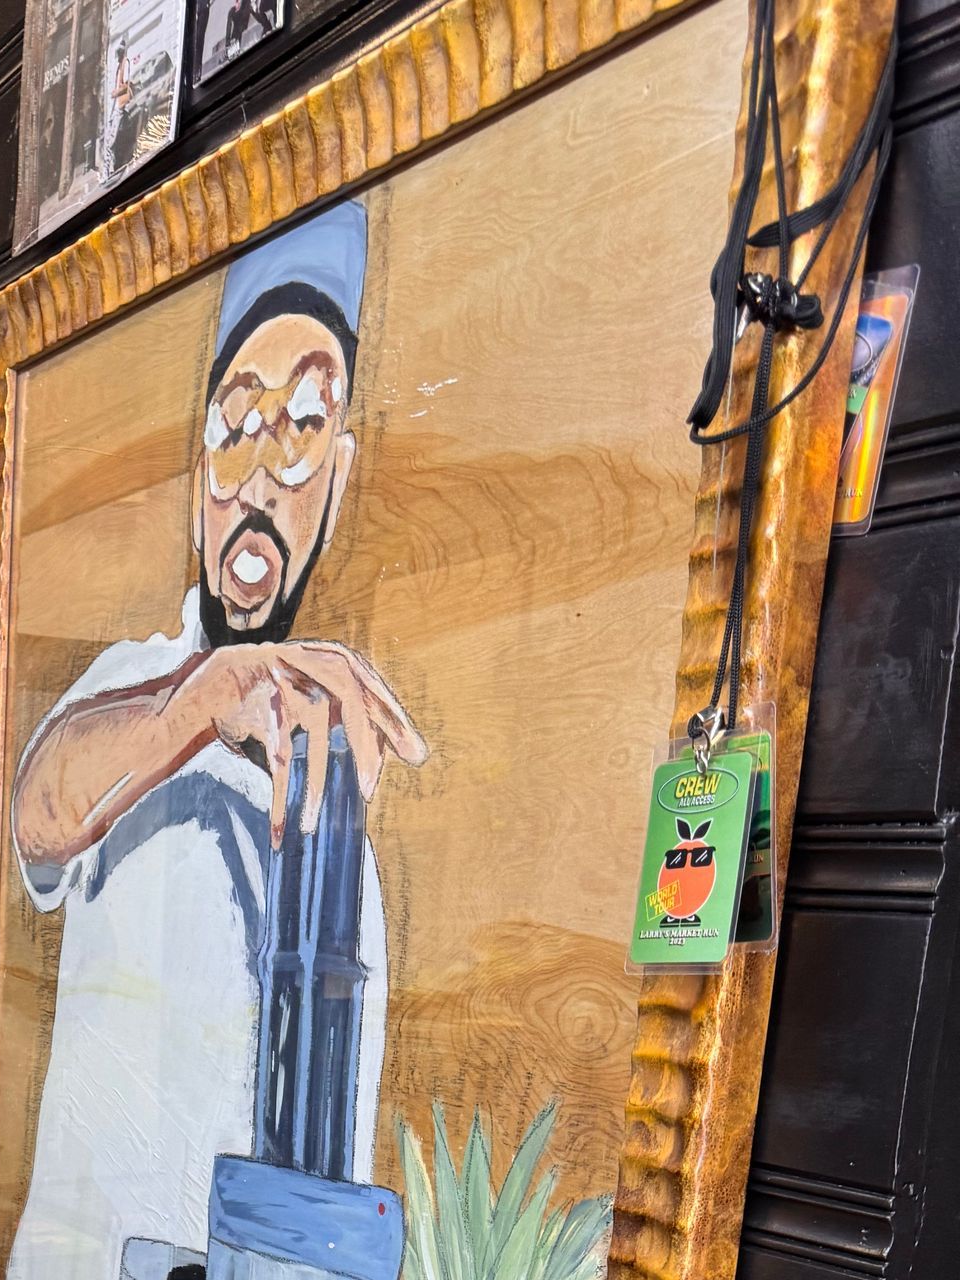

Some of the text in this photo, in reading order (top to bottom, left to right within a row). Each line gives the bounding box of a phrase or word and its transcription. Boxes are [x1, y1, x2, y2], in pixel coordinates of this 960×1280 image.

[675, 773, 721, 798] CREW
[691, 794, 715, 806] ACCESS
[649, 884, 678, 907] WORLD
[654, 896, 675, 915] TOUR
[639, 928, 720, 939] LARRY'S MARKET RUN
